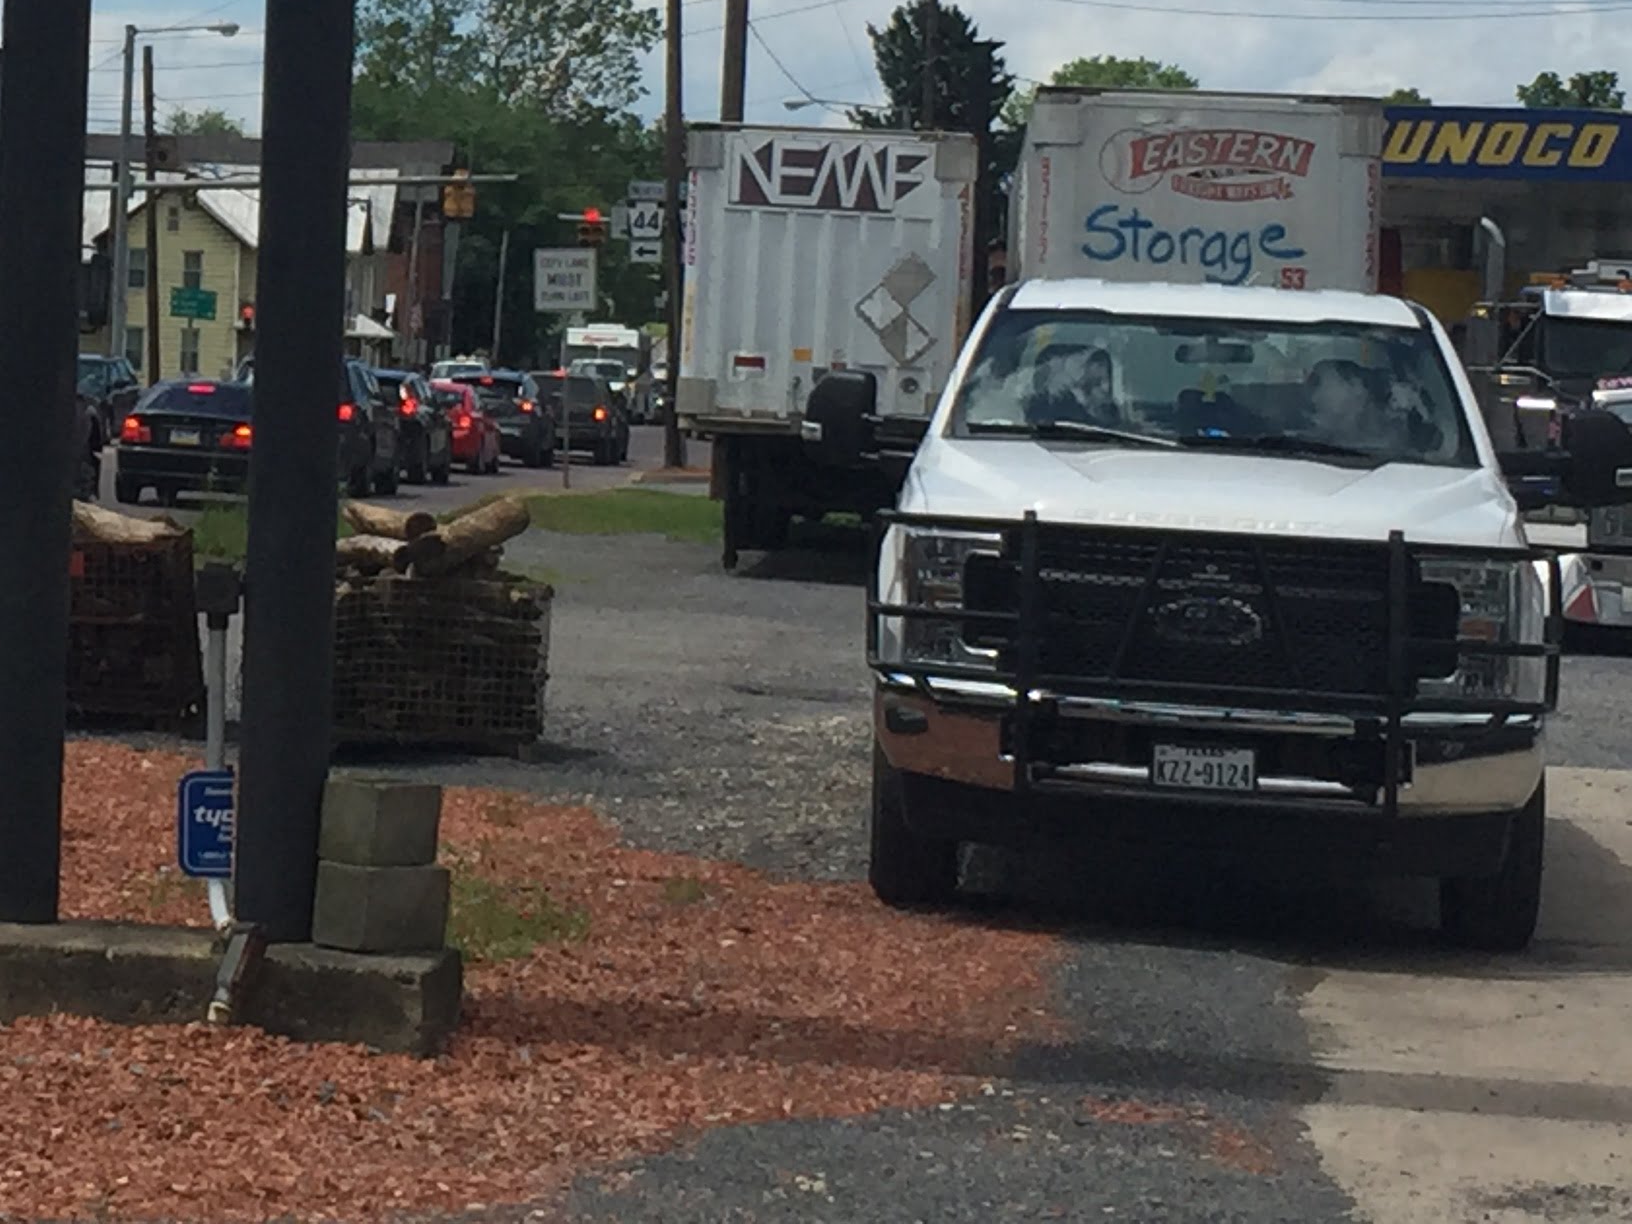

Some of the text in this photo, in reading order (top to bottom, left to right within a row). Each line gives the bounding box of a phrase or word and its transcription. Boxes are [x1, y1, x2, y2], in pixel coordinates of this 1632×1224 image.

[1142, 132, 1306, 172] EASTERN
[1382, 119, 1620, 168] UNOCO
[632, 210, 660, 231] 44
[1081, 204, 1307, 286] Storage
[193, 805, 234, 827] tyc
